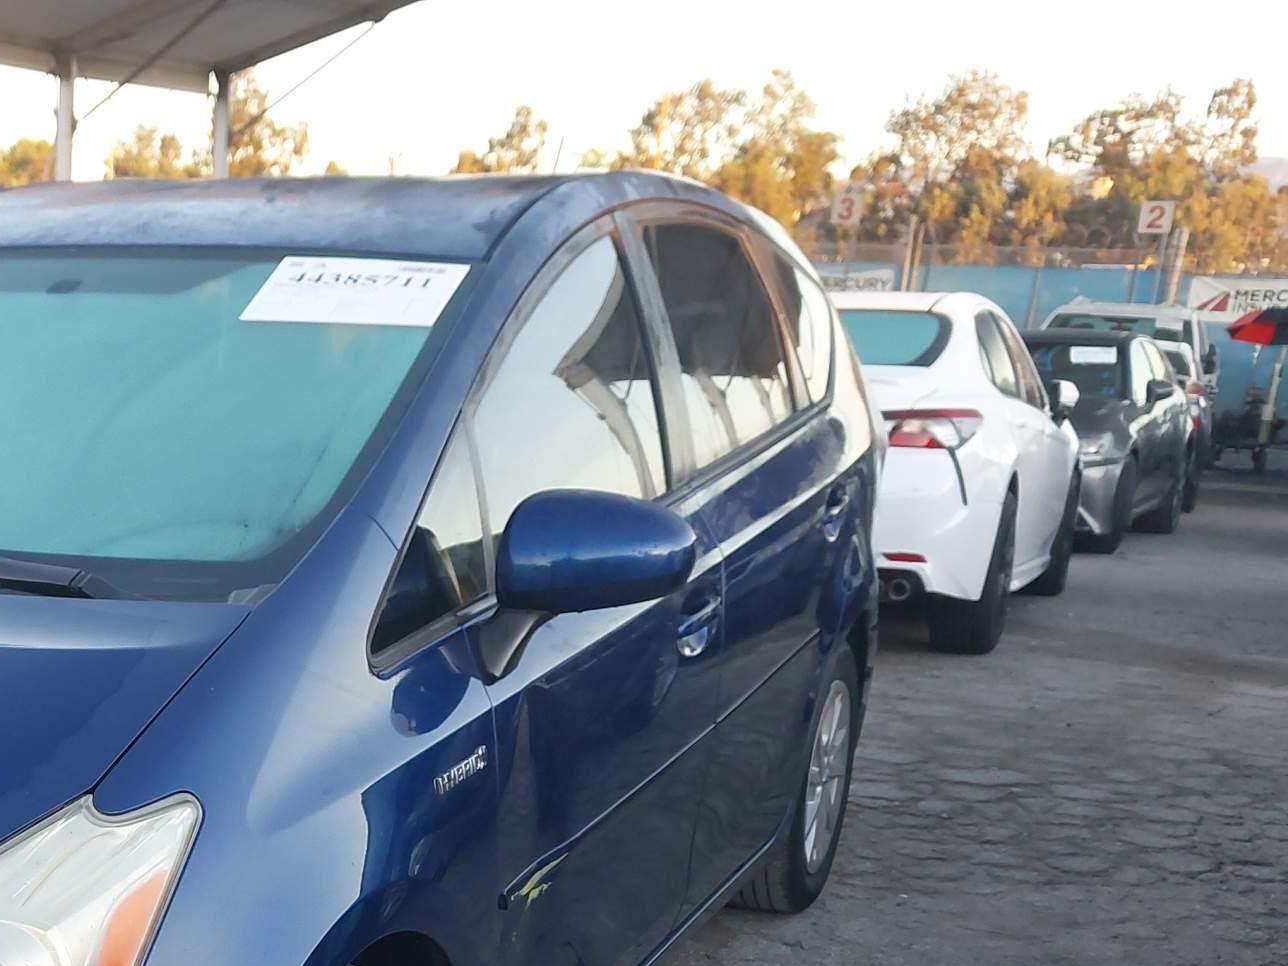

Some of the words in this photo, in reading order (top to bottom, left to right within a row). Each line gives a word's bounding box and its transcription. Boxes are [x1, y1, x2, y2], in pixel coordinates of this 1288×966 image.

[839, 197, 854, 220] 3
[1146, 205, 1165, 229] 2
[289, 272, 431, 289] 44385711
